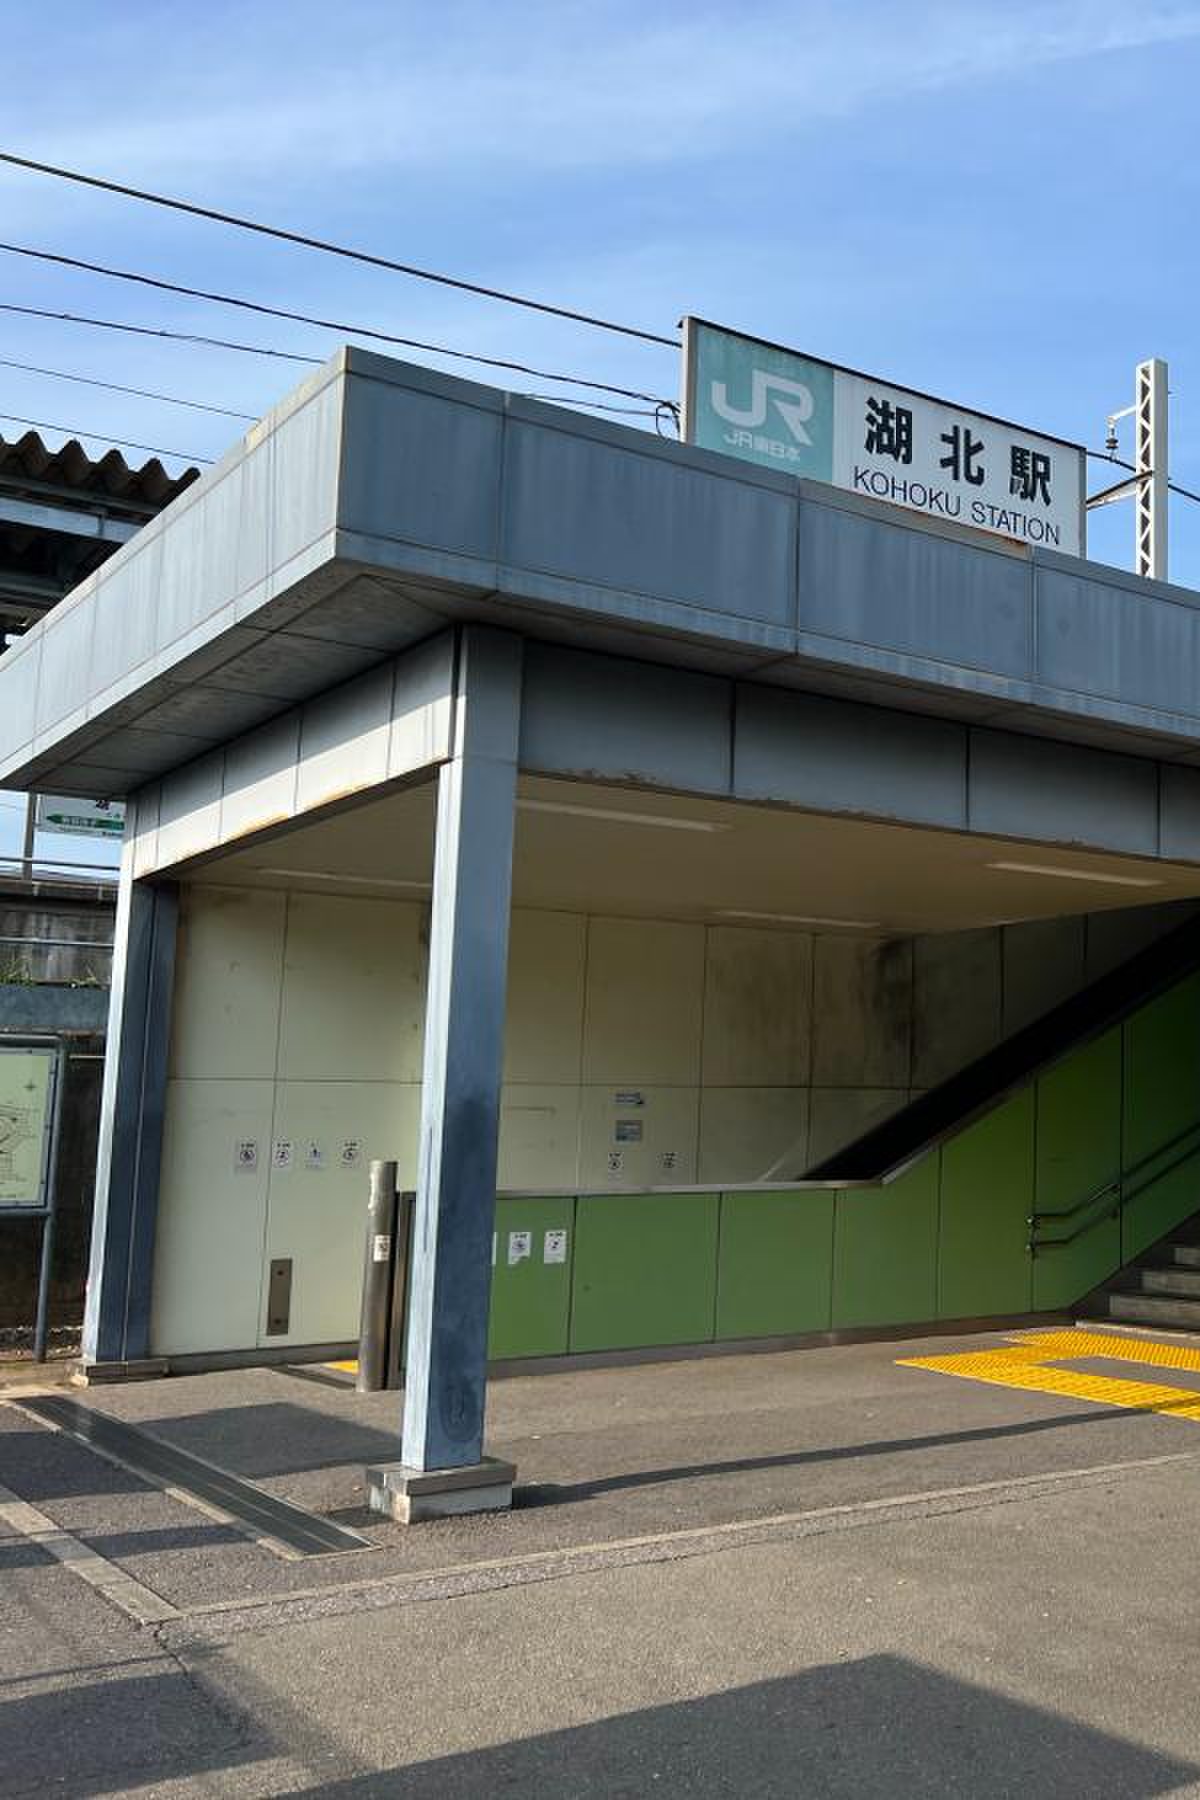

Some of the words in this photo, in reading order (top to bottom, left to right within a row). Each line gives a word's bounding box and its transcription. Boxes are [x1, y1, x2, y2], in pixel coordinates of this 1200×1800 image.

[711, 369, 813, 446] JR
[864, 396, 1051, 507] 湖北駅
[854, 466, 960, 517] KOHOKU
[971, 501, 1060, 546] STATION
